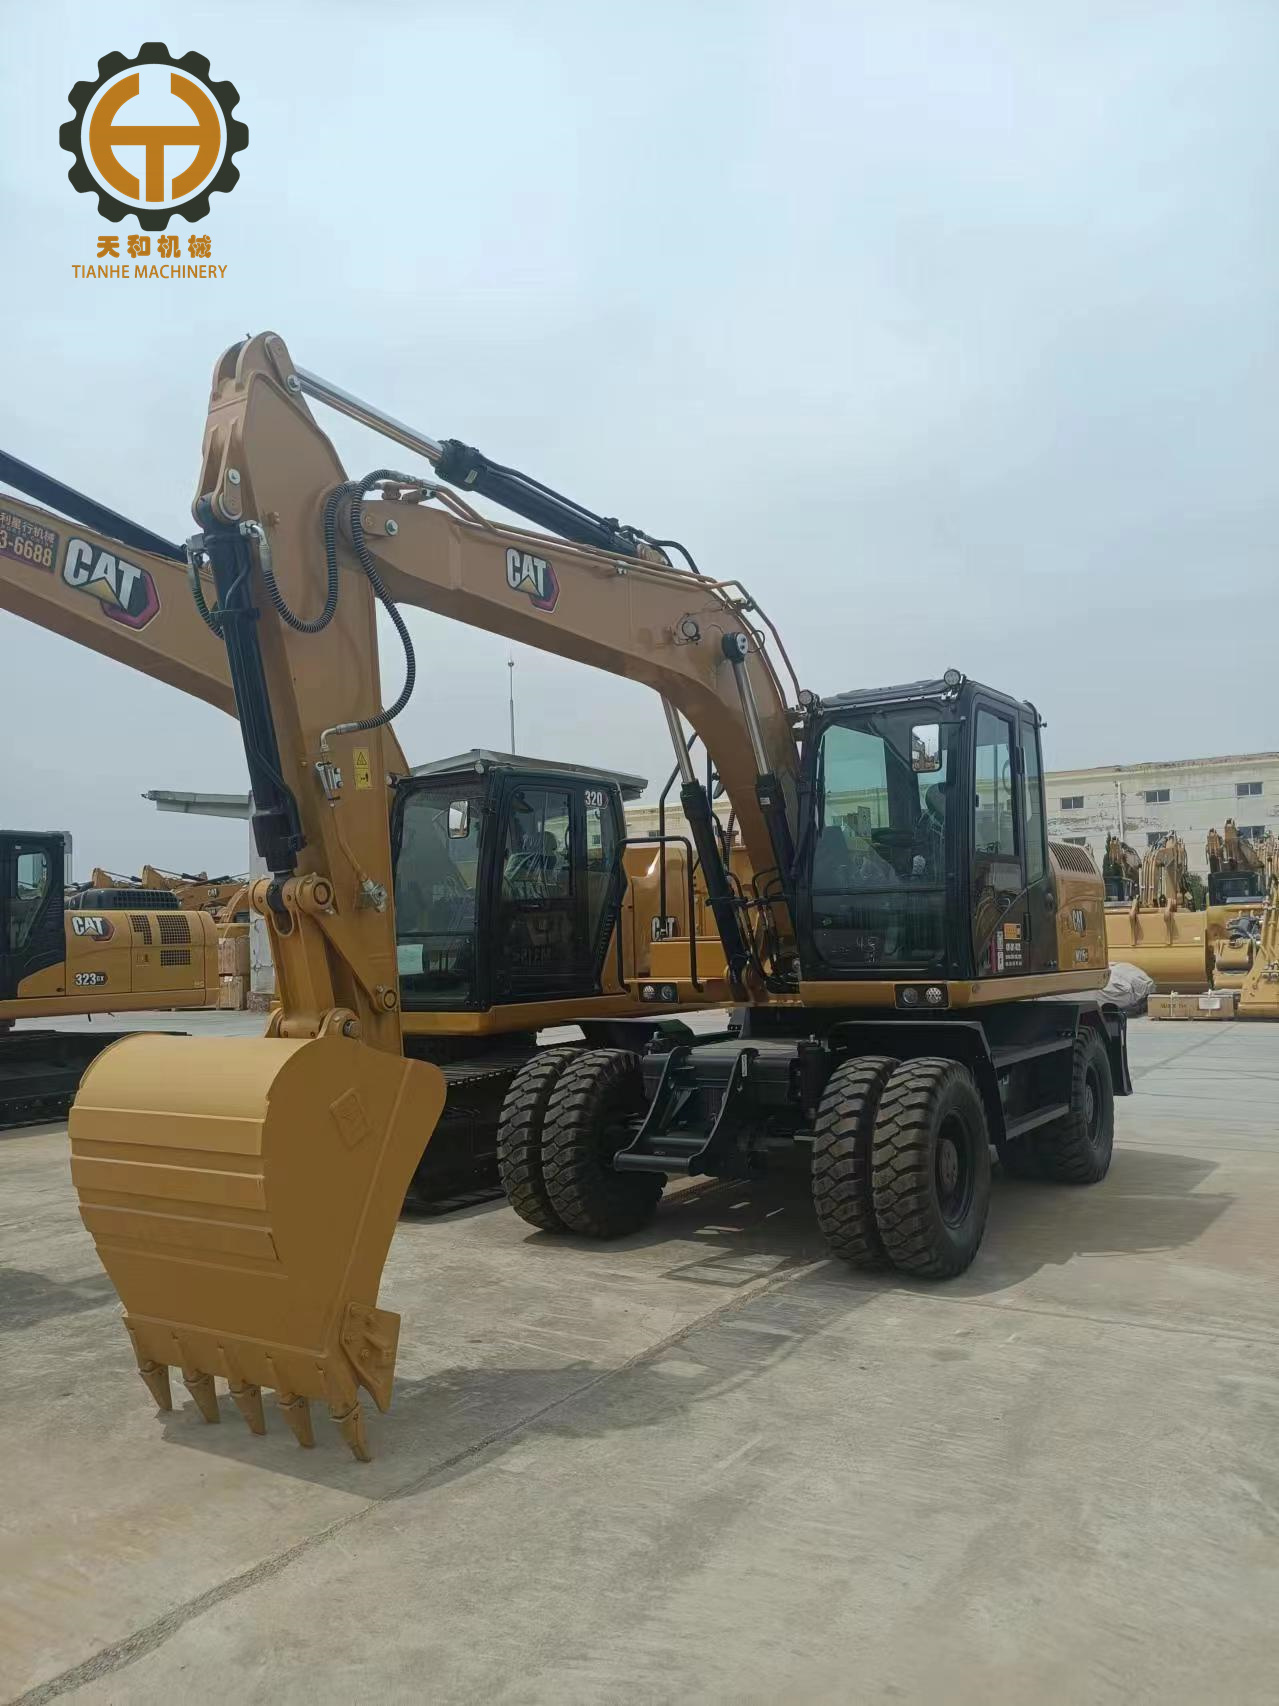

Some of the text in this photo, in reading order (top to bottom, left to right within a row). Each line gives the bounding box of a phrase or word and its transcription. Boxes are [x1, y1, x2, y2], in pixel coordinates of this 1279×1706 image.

[63, 538, 142, 611] CAT
[506, 548, 547, 598] CAT
[585, 790, 603, 807] 320
[71, 916, 104, 937] CAT
